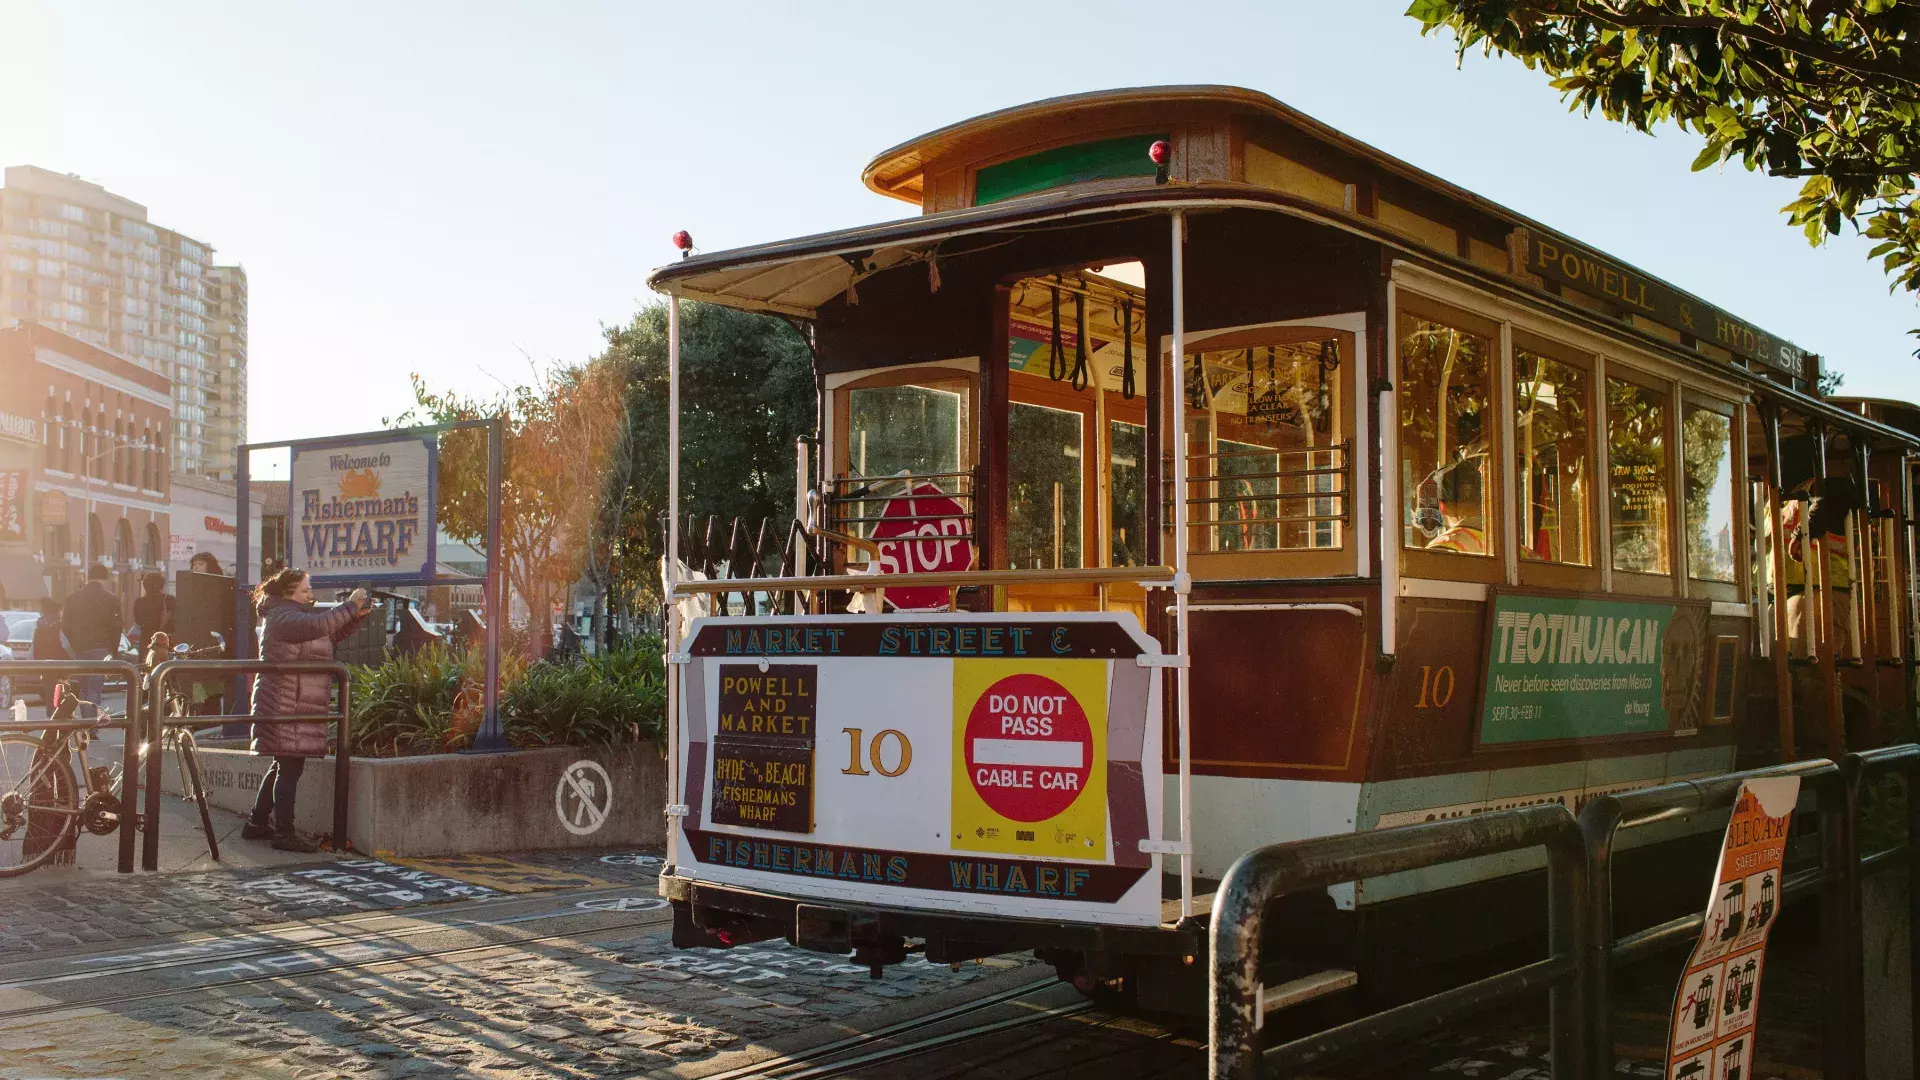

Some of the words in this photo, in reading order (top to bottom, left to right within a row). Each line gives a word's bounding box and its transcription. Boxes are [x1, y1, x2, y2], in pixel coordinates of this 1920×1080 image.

[1537, 240, 1655, 312] POWELL
[1680, 303, 1693, 329] &
[1715, 315, 1769, 360] HYDE
[1780, 346, 1802, 372] Sts
[1260, 401, 1288, 411] CLEAR
[1231, 417, 1242, 425] NO
[1245, 413, 1291, 423] TRANSFERS
[330, 454, 377, 471] Welcome
[380, 452, 391, 467] to
[302, 489, 419, 521] Fisherman's
[302, 519, 419, 567] WHARF
[878, 519, 963, 574] STOP
[307, 560, 324, 569] SAN
[332, 558, 386, 568] FRANCISCO
[726, 627, 844, 654] MARKET
[879, 626, 1032, 655] STREET
[1497, 611, 1659, 664] TEOTIHUACAN
[724, 677, 809, 697] POWELL
[1415, 665, 1455, 708] 10
[1495, 675, 1522, 692] Never
[1522, 674, 1550, 692] before
[1550, 678, 1570, 691] seen
[1570, 674, 1612, 691] discoveries
[1611, 674, 1628, 690] from
[1628, 673, 1652, 690] Mexico
[744, 699, 787, 713] AND
[989, 695, 1018, 714] DO
[1023, 695, 1067, 715] NOT
[1624, 701, 1632, 715] de
[1632, 700, 1651, 716] Young
[720, 713, 810, 734] MARKET
[1001, 716, 1053, 736] PASS
[841, 727, 913, 777] 10
[717, 758, 746, 781] HYDE
[765, 762, 806, 786] BEACH
[976, 768, 1033, 789] CABLE
[1039, 771, 1078, 790] CAR
[723, 786, 796, 806] FISHERMANS
[739, 804, 777, 822] WHARF
[708, 836, 908, 882] FISHERMANS
[949, 860, 1091, 897] WHARF
[1735, 851, 1762, 872] SAFETY
[1763, 845, 1781, 864] TIPS
